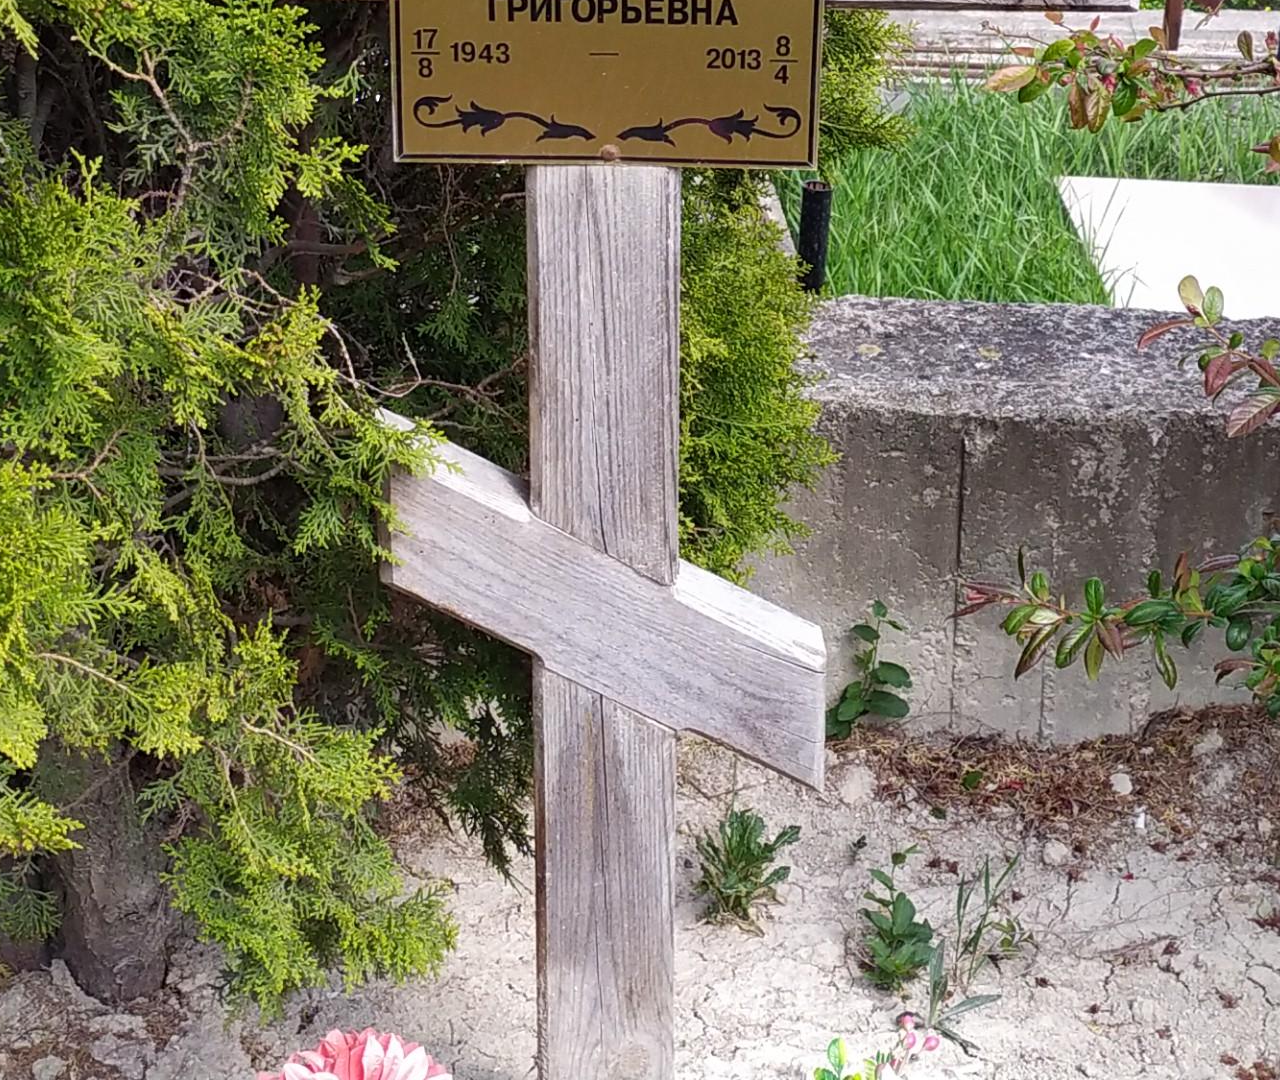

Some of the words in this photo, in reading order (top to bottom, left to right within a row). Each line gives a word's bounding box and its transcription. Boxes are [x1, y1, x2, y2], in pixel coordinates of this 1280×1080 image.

[412, 28, 439, 50] 17
[775, 35, 791, 57] 8
[449, 41, 511, 65] 1943
[705, 47, 763, 71] 2013
[418, 57, 434, 79] 8
[774, 64, 790, 85] 4
